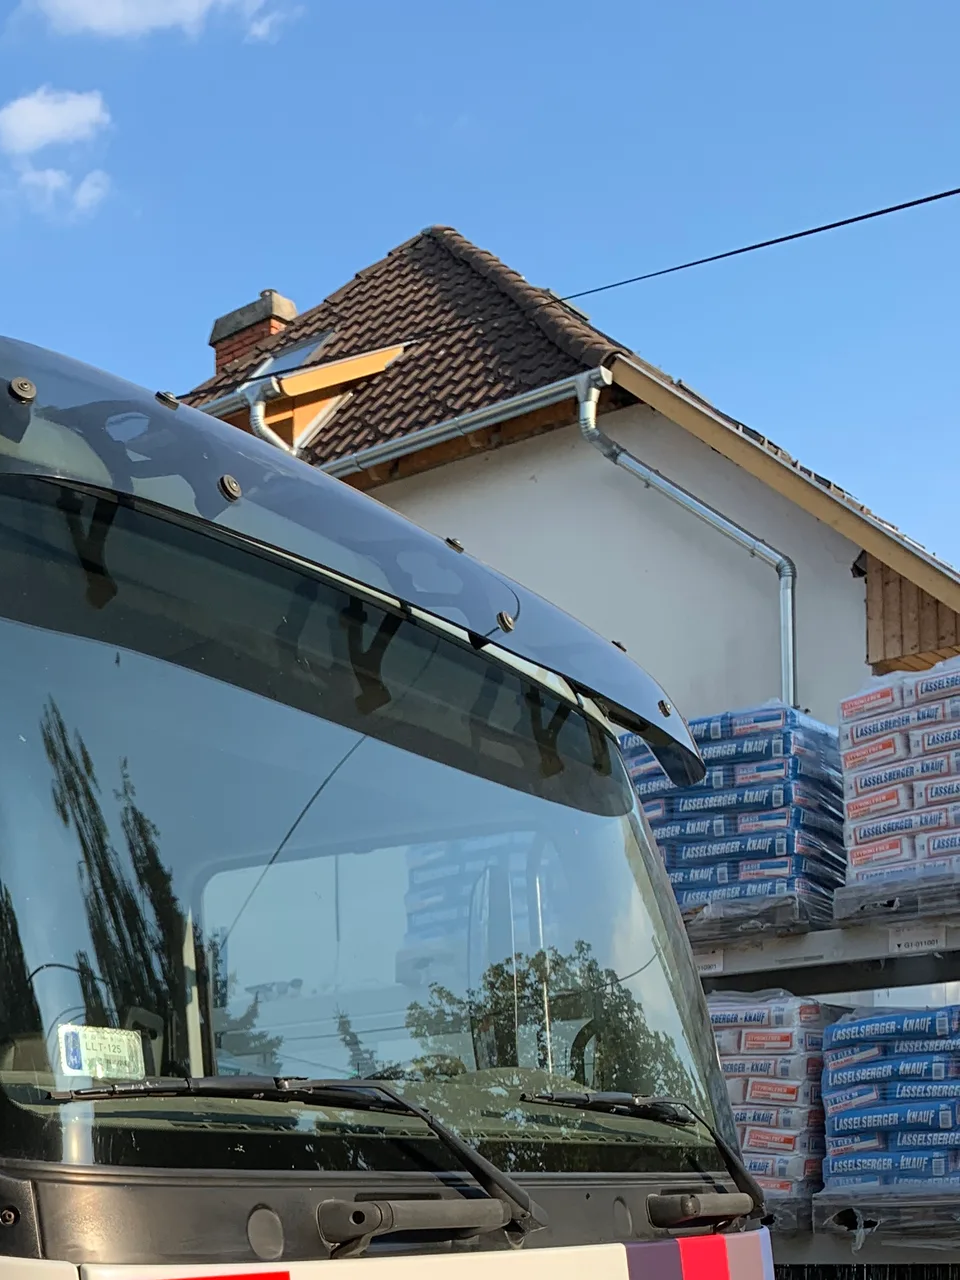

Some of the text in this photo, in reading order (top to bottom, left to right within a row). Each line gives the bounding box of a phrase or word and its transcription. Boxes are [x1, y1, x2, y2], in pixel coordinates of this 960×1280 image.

[856, 715, 910, 739] LASSELSBERGER
[917, 707, 939, 721] KNAUF
[743, 739, 768, 754] KNAUF
[860, 766, 914, 789] LASSELSBERGER
[920, 758, 944, 774] KNAUF
[679, 793, 737, 812] LASSELSBERGER
[743, 789, 769, 804] KNAUF
[686, 820, 710, 835] KNAUF
[859, 818, 913, 840] LASSELSBERGER
[920, 812, 943, 826] KNAUF
[682, 841, 740, 860] LASSELSBERGER
[746, 837, 772, 853] KNAUF
[689, 867, 714, 881] KNAUF
[744, 1011, 766, 1025] KNAUF
[832, 1021, 896, 1041] LASSELSBERGER
[903, 1017, 931, 1033] KNAUF
[85, 1042, 122, 1054] LLT-125
[751, 1061, 772, 1076] KNAUF
[828, 1065, 892, 1086] LASSELSBERGER
[899, 1061, 928, 1077] KNAUF
[752, 1111, 774, 1125] KNAUF
[834, 1112, 898, 1131] LASSELSBERGER
[906, 1109, 935, 1125] KNAUF
[749, 1160, 770, 1174] KNAUF
[829, 1157, 892, 1174] LASSELSBERGER
[900, 1155, 928, 1172] KNAUF
